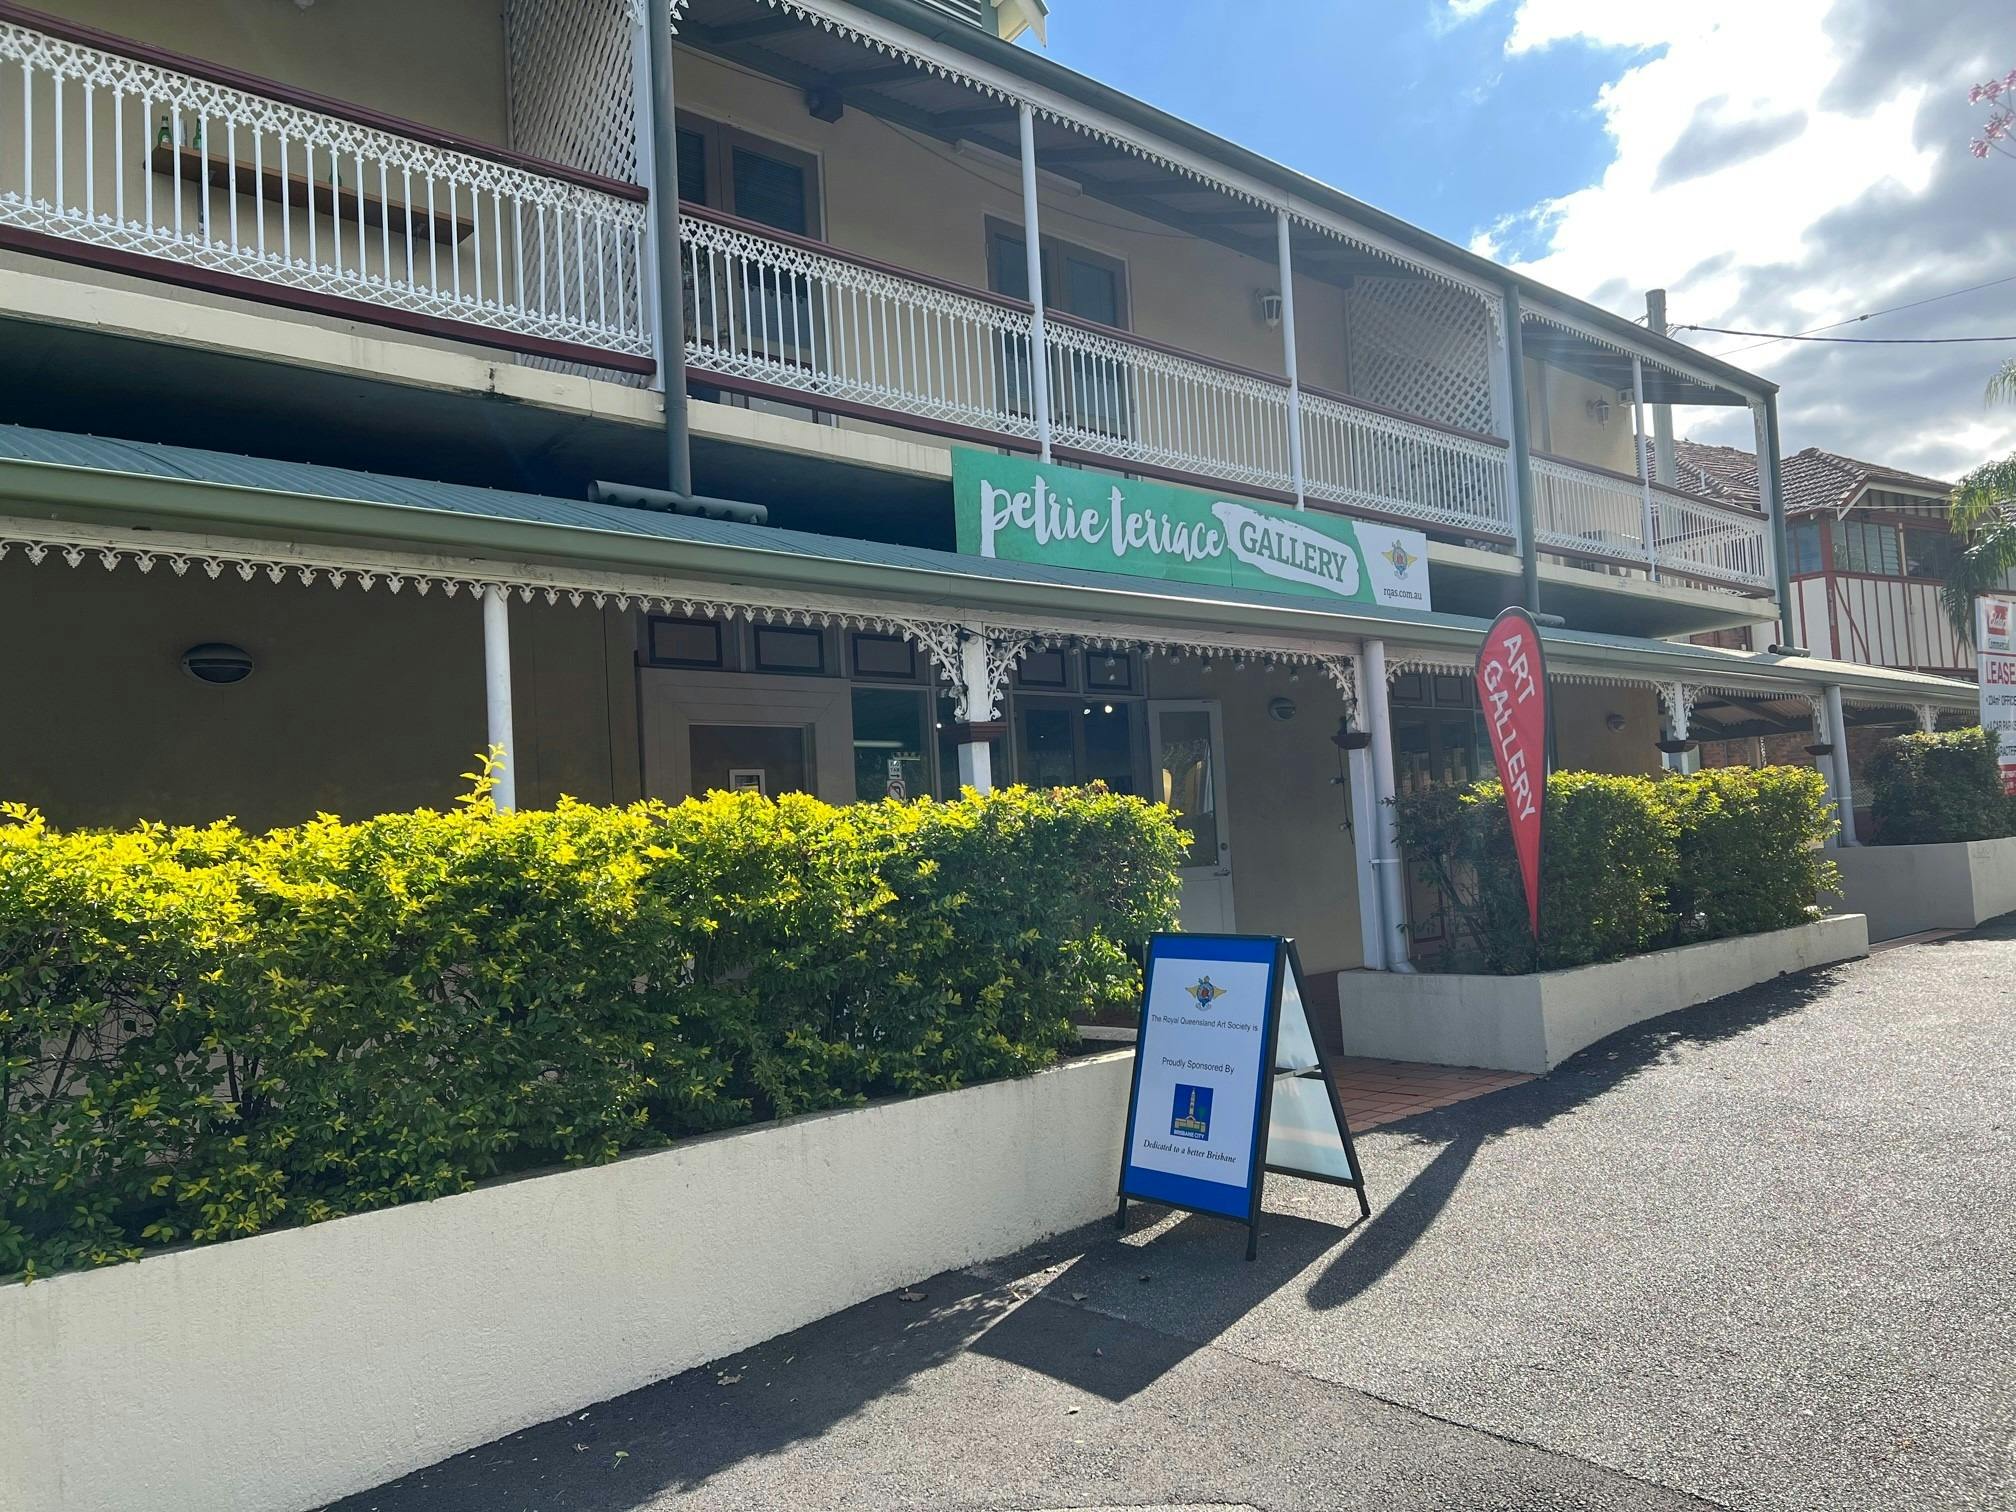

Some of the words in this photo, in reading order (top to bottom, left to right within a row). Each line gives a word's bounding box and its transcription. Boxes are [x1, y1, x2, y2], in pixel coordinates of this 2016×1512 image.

[980, 475, 1109, 558] petrie
[1107, 485, 1225, 562] terrace
[1239, 521, 1347, 583] GALLERY
[1383, 588, 1423, 600] rqas.com.au
[1503, 634, 1535, 703] ART
[1485, 660, 1535, 822] GALLERY
[1151, 1014, 1162, 1023] The
[1163, 1015, 1180, 1025] Royal
[1180, 1016, 1216, 1028] Queensland
[1217, 1020, 1226, 1029] Art
[1227, 1021, 1251, 1033] Society
[1162, 1056, 1186, 1069] Proudly
[1187, 1060, 1224, 1073] Sponsored
[1224, 1064, 1235, 1075] By
[1143, 1139, 1173, 1152] Dedicated
[1173, 1145, 1180, 1153] to
[1187, 1147, 1205, 1158] better
[1206, 1150, 1237, 1163] Brisbane
